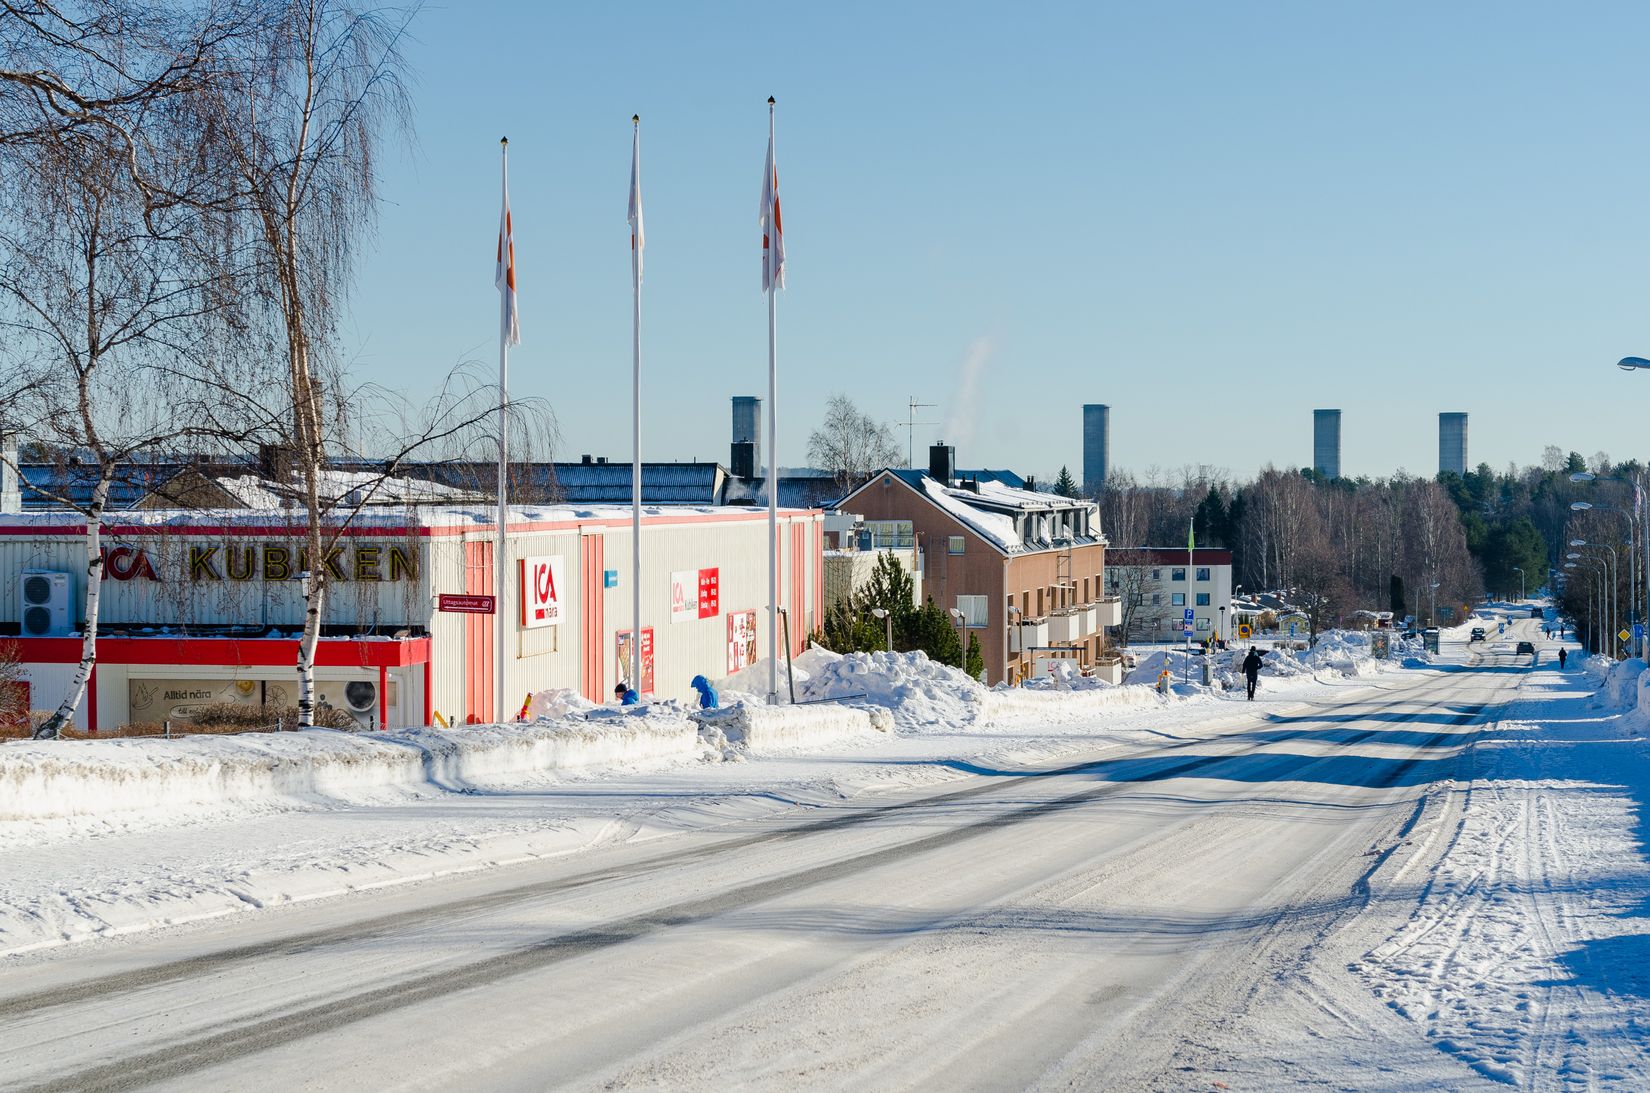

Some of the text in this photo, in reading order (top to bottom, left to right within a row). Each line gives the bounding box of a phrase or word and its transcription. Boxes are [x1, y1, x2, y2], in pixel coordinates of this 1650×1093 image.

[100, 546, 157, 581] ICA
[534, 563, 557, 605] ICA
[673, 582, 684, 605] ICA
[545, 604, 558, 618] nära
[163, 689, 212, 700] Alltid nära
